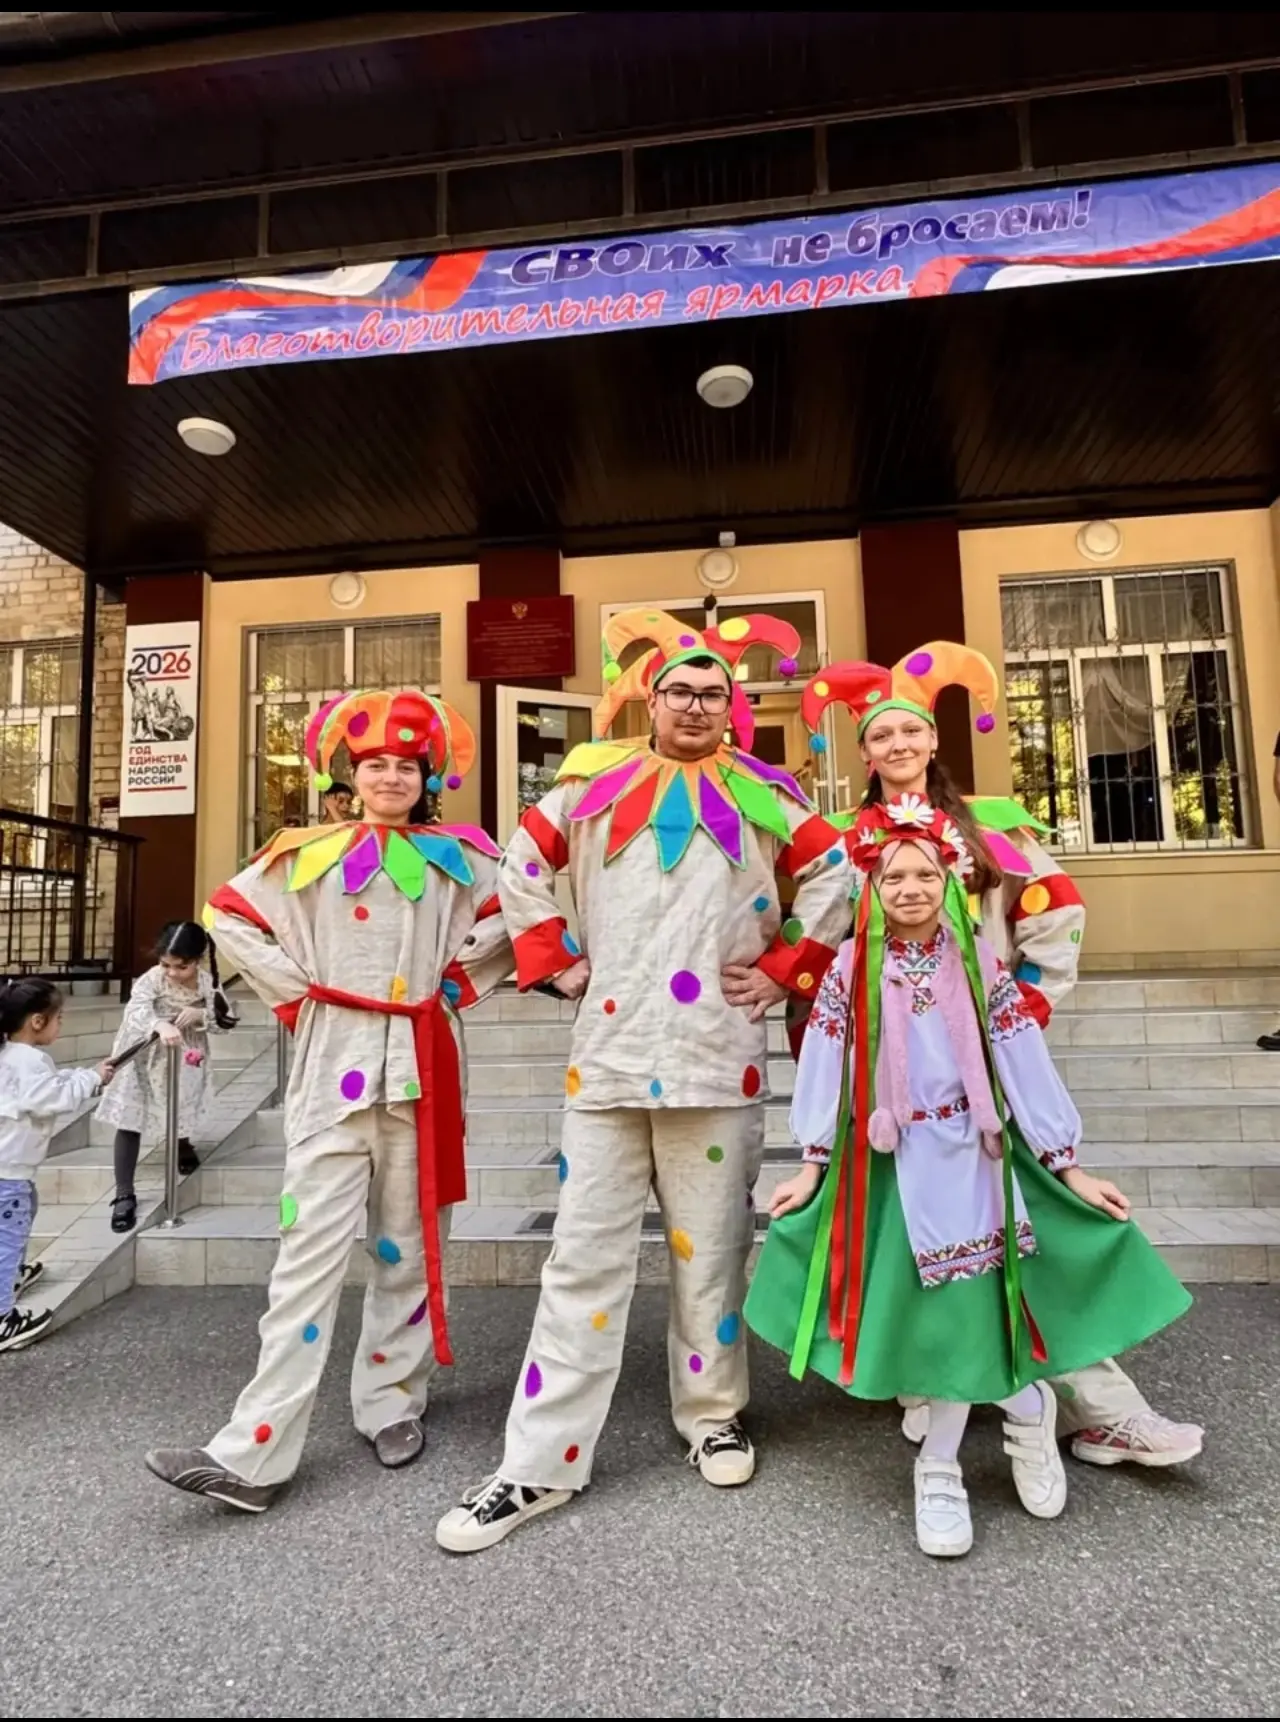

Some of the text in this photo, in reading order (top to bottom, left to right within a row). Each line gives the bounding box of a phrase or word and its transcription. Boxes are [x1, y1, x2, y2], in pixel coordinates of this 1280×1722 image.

[510, 188, 1093, 286] СВОих не бросаем!
[179, 288, 668, 371] Благотворительная
[131, 650, 192, 676] 2026
[129, 745, 152, 755] ГОД
[128, 753, 188, 766] ЕДИНСТВА
[128, 764, 183, 776] НАРОДОВ
[128, 775, 176, 786] РОССИИ
